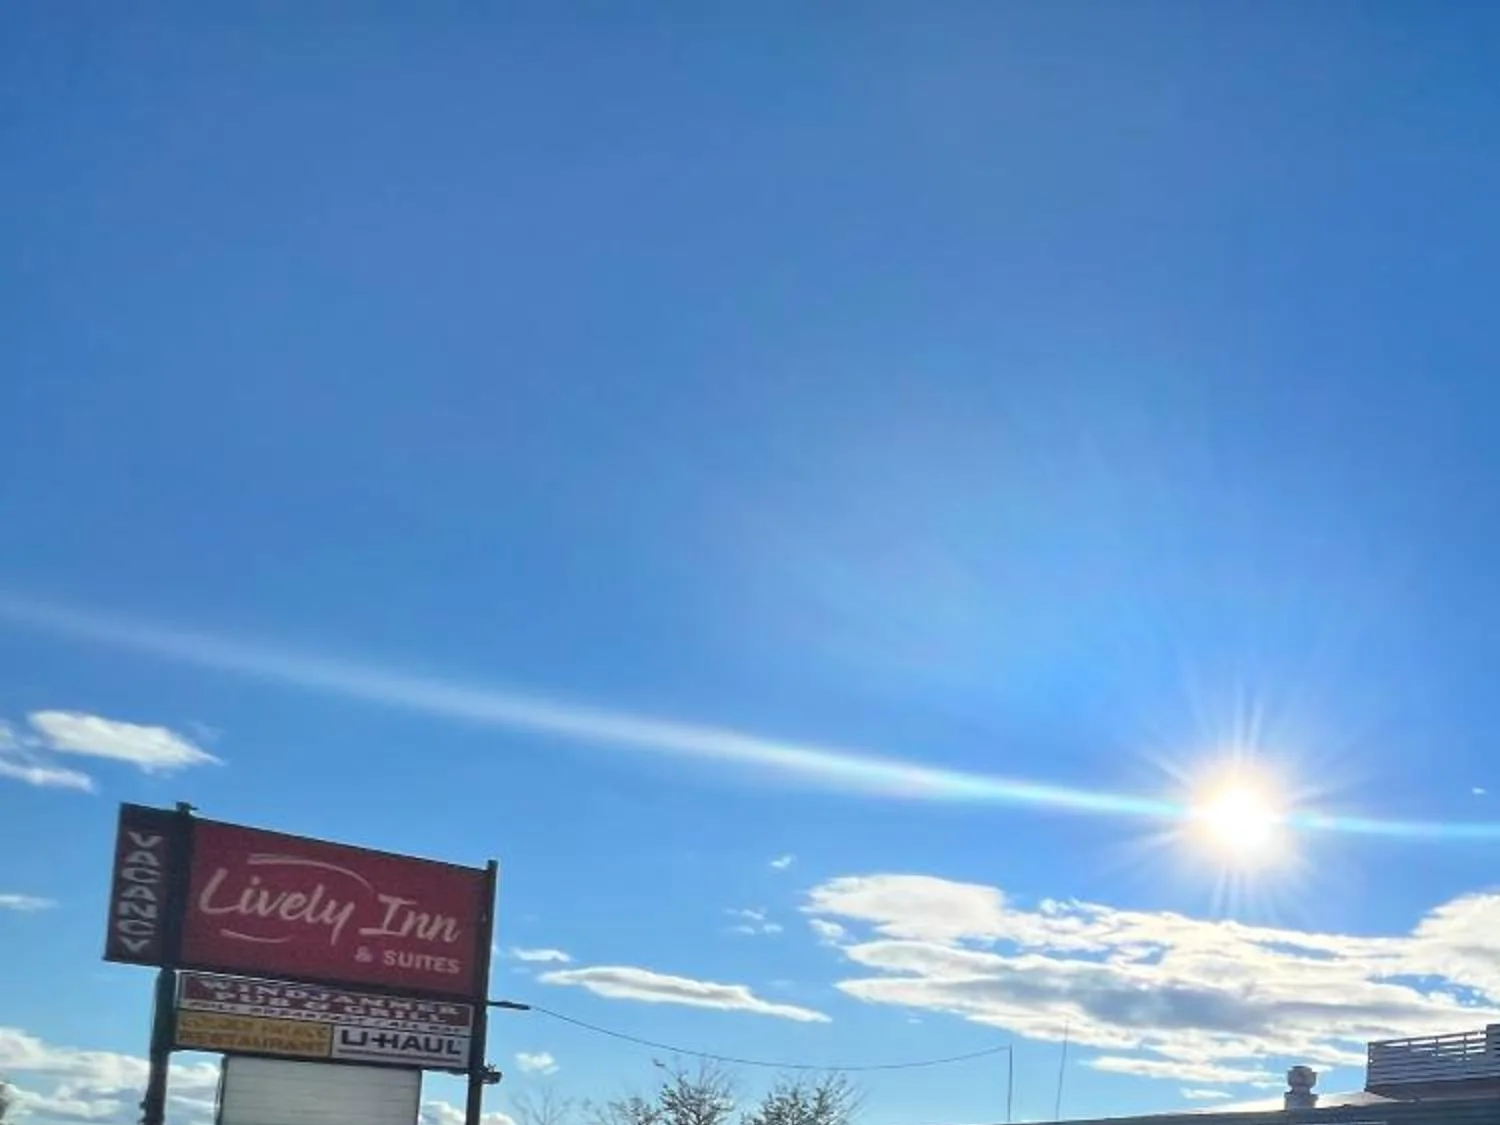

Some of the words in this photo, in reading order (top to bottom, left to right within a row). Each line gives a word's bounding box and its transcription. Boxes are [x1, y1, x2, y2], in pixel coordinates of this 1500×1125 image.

[116, 831, 164, 953] VACANCY
[199, 867, 356, 946] Lively
[359, 893, 462, 944] Inn
[354, 946, 373, 963] &
[383, 949, 461, 975] SUITES
[341, 1029, 462, 1055] U-HAUL
